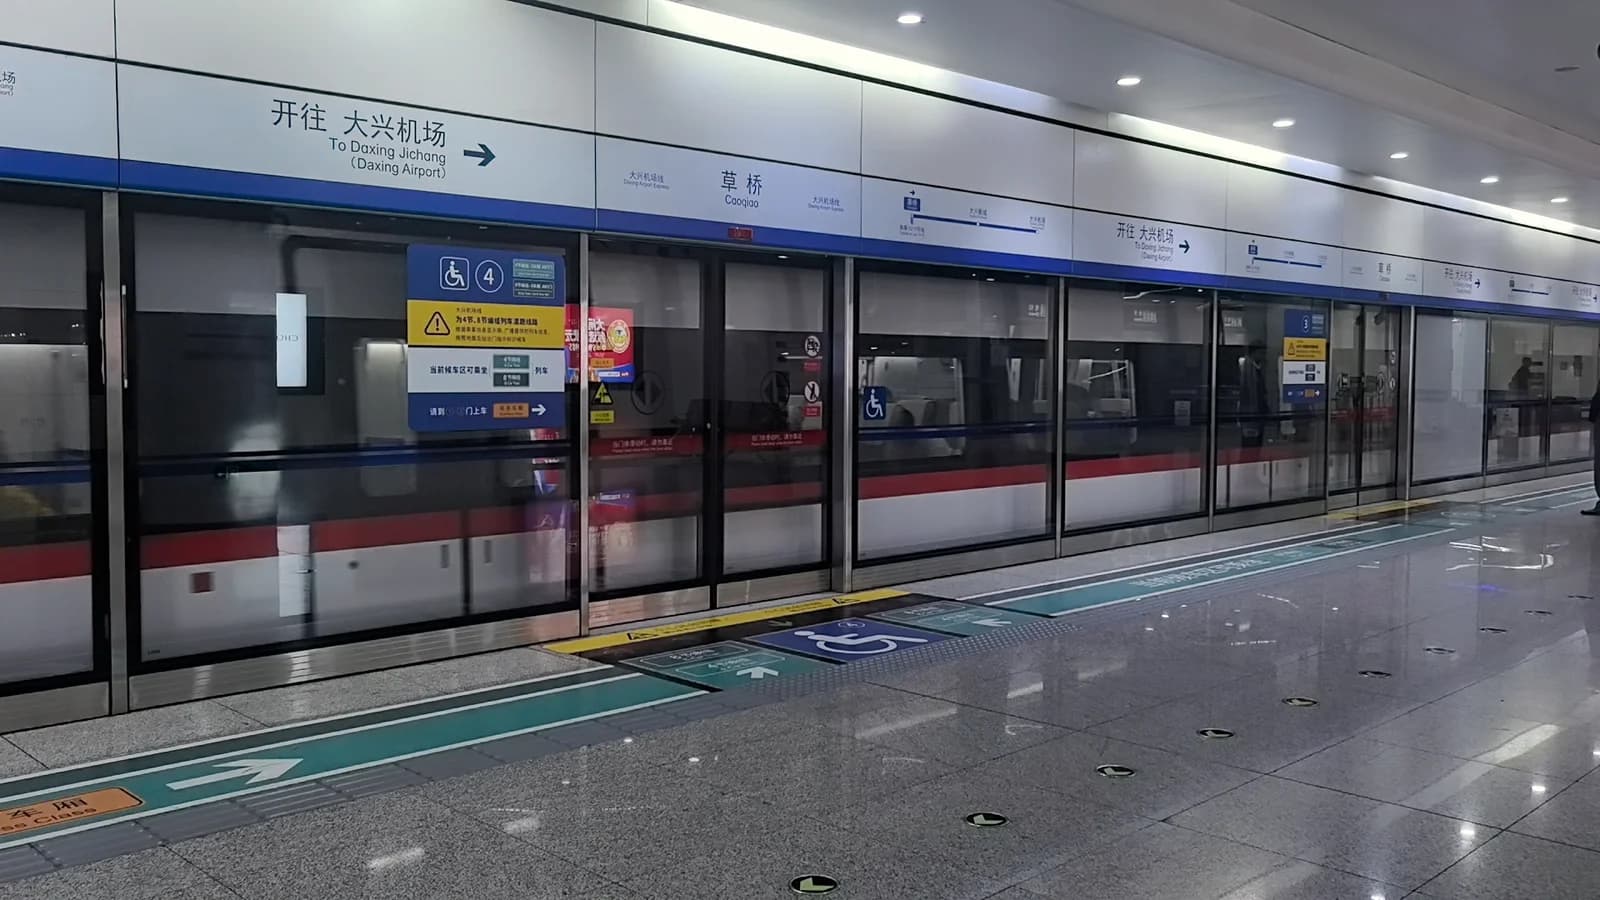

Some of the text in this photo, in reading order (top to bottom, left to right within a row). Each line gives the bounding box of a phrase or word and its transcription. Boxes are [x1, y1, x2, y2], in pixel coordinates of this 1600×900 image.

[0, 71, 16, 85] 场
[271, 99, 447, 148] 开往 大兴机场
[328, 137, 446, 166] To Daxing Jichang
[350, 156, 446, 179] (Daxing Airport)
[720, 169, 763, 197] 草桥
[724, 194, 759, 209] Caoqiao
[1139, 224, 1174, 244] 大兴机场
[483, 267, 495, 286] 4
[33, 807, 97, 825] Class
